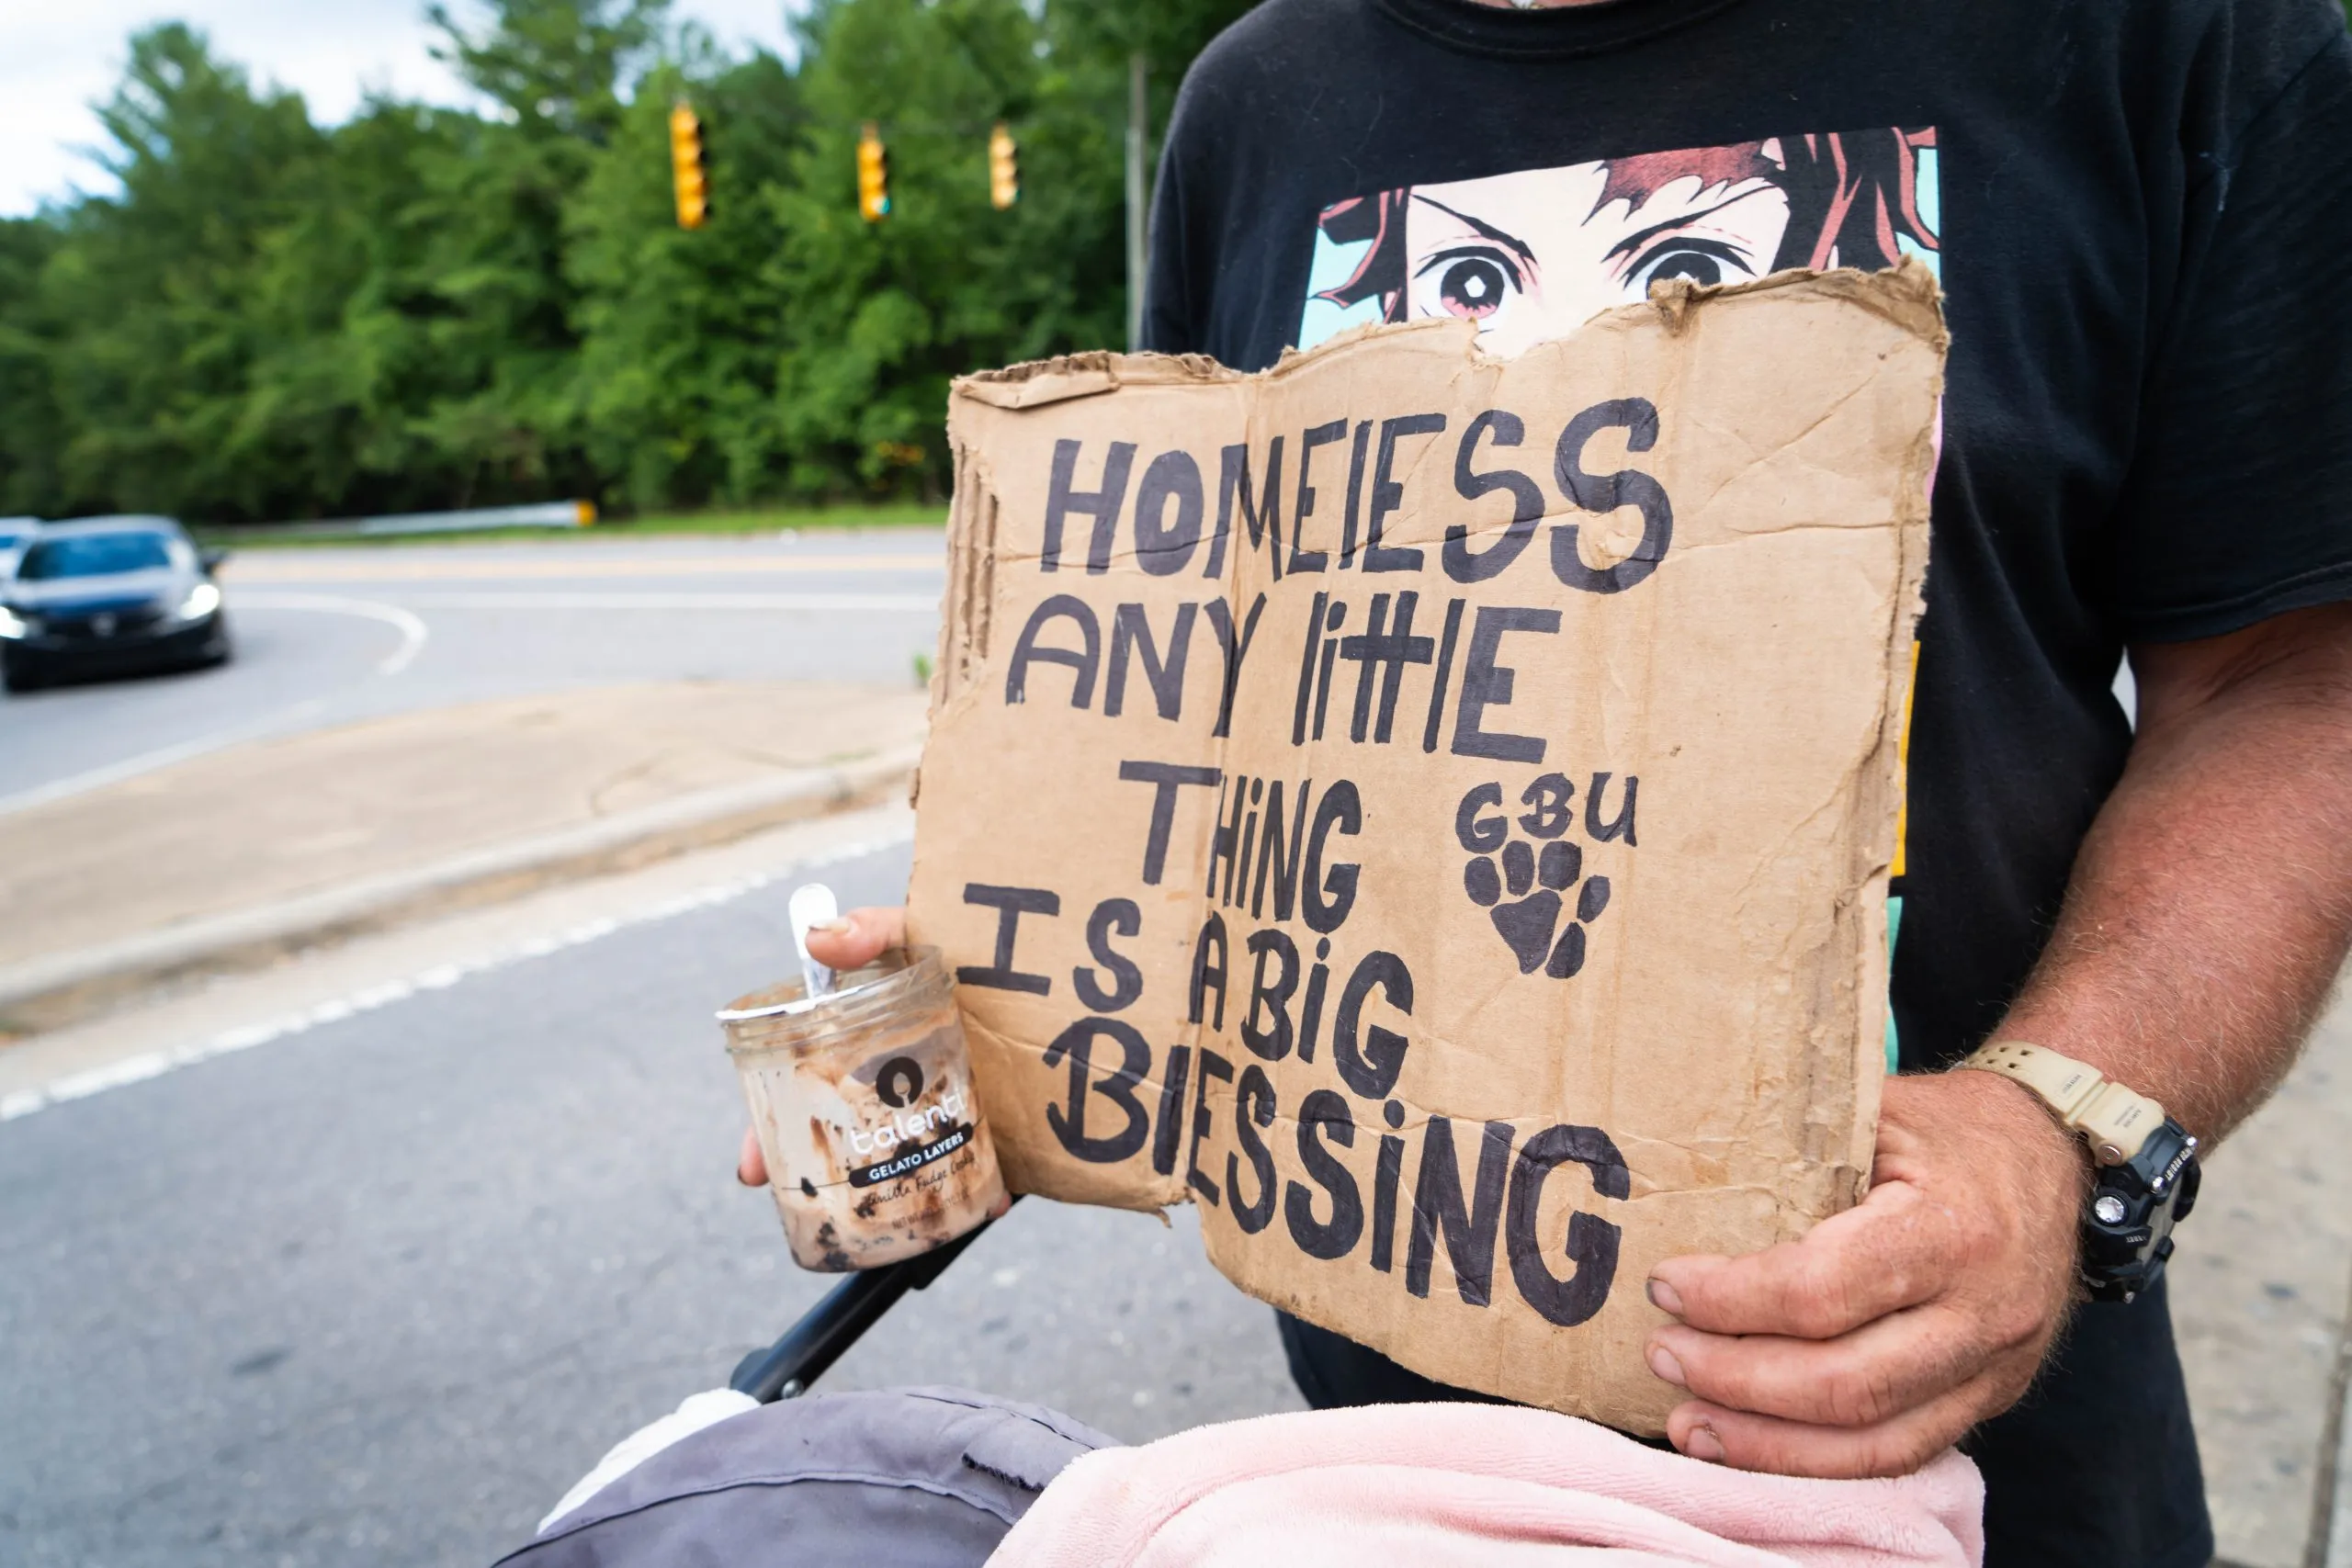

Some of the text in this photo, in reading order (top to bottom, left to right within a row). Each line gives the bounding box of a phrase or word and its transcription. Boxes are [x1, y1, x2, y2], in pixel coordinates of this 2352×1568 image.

[1006, 592, 1267, 738] ANY
[1455, 772, 1639, 855] GBU
[956, 883, 1144, 1013] IS
[1188, 910, 1228, 1032] A
[850, 1082, 966, 1155] talenti
[868, 1132, 964, 1180] GELATO LAYERS
[915, 1169, 947, 1191] Fudge
